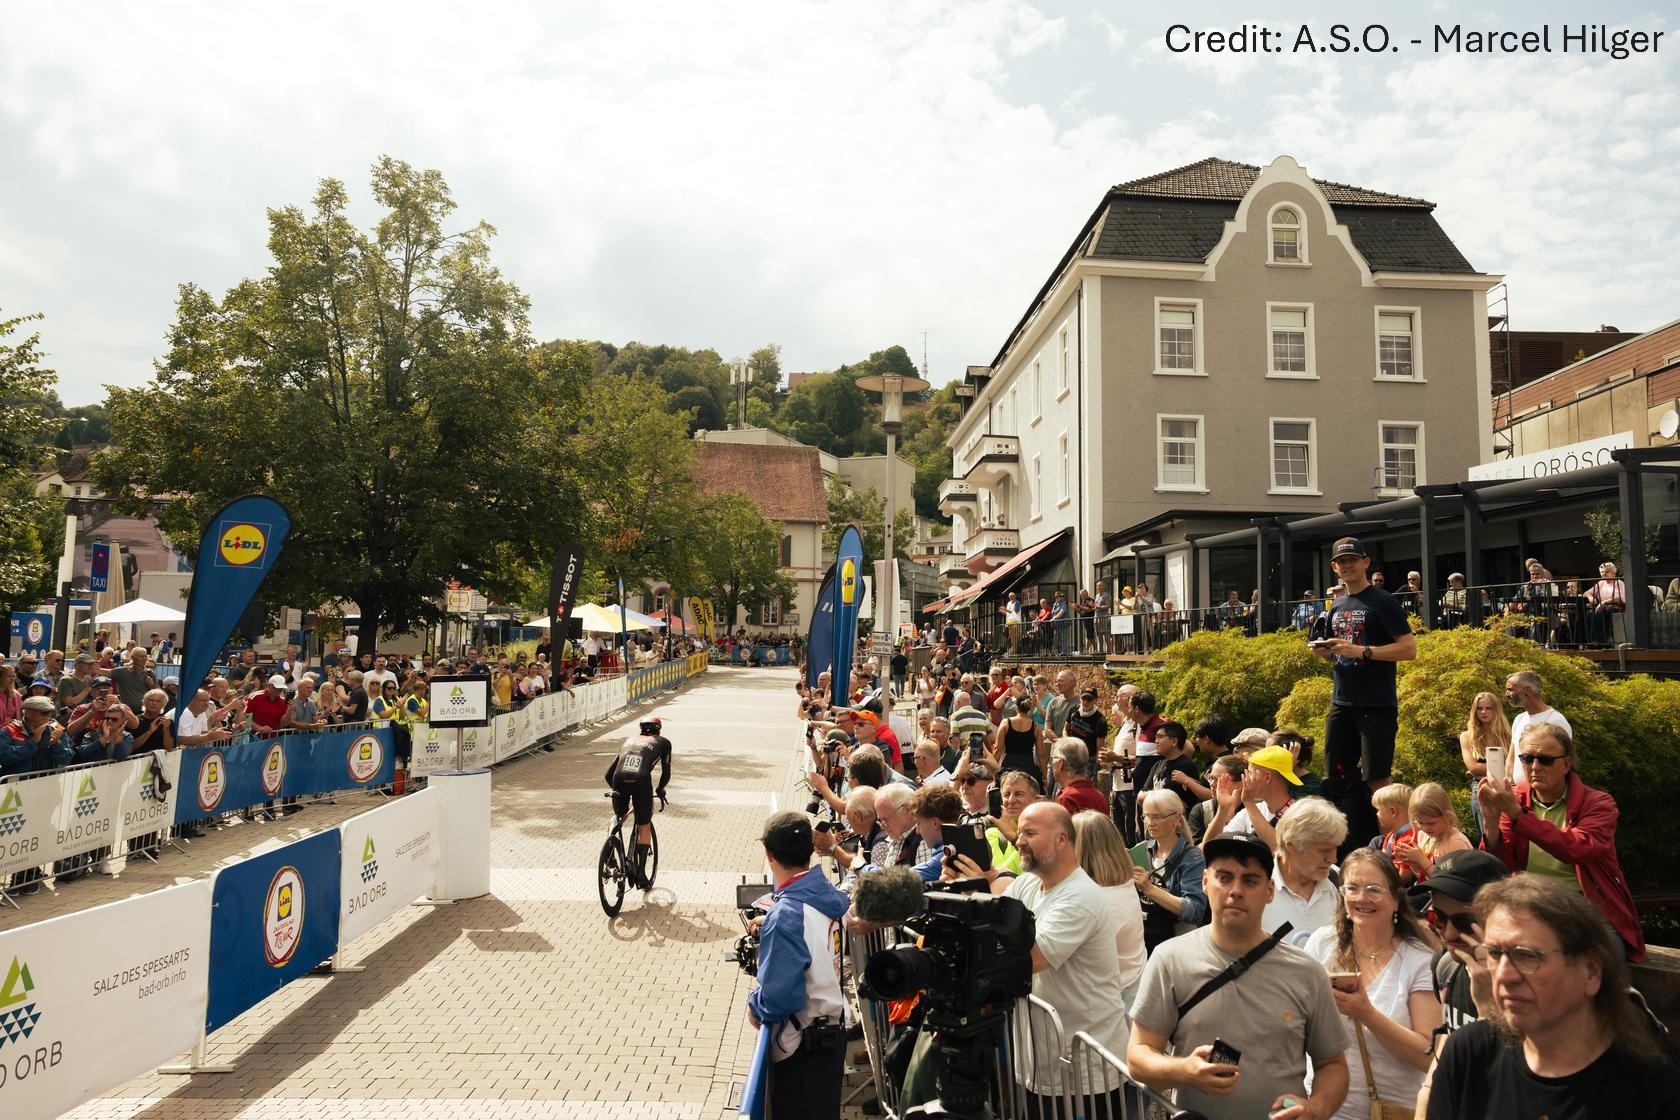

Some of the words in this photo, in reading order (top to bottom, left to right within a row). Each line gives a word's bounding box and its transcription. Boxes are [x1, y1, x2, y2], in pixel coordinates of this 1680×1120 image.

[92, 577, 107, 588] TAXI
[560, 553, 577, 603] TISSOT
[691, 603, 704, 625] ADAC
[440, 707, 458, 715] BAD
[459, 707, 477, 715] ORB
[624, 756, 641, 768] 103
[124, 808, 147, 826] BAD
[148, 802, 169, 819] ORB
[56, 825, 83, 845] BAD
[85, 818, 110, 836] ORB
[9, 836, 39, 857] ORB
[348, 892, 368, 914] BAD
[369, 881, 387, 903] ORB
[93, 974, 120, 996] SALZ
[121, 966, 141, 986] DES
[142, 947, 190, 979] SPESSARTS
[138, 968, 187, 999] bad-orb.info
[14, 1040, 63, 1081] ORB
